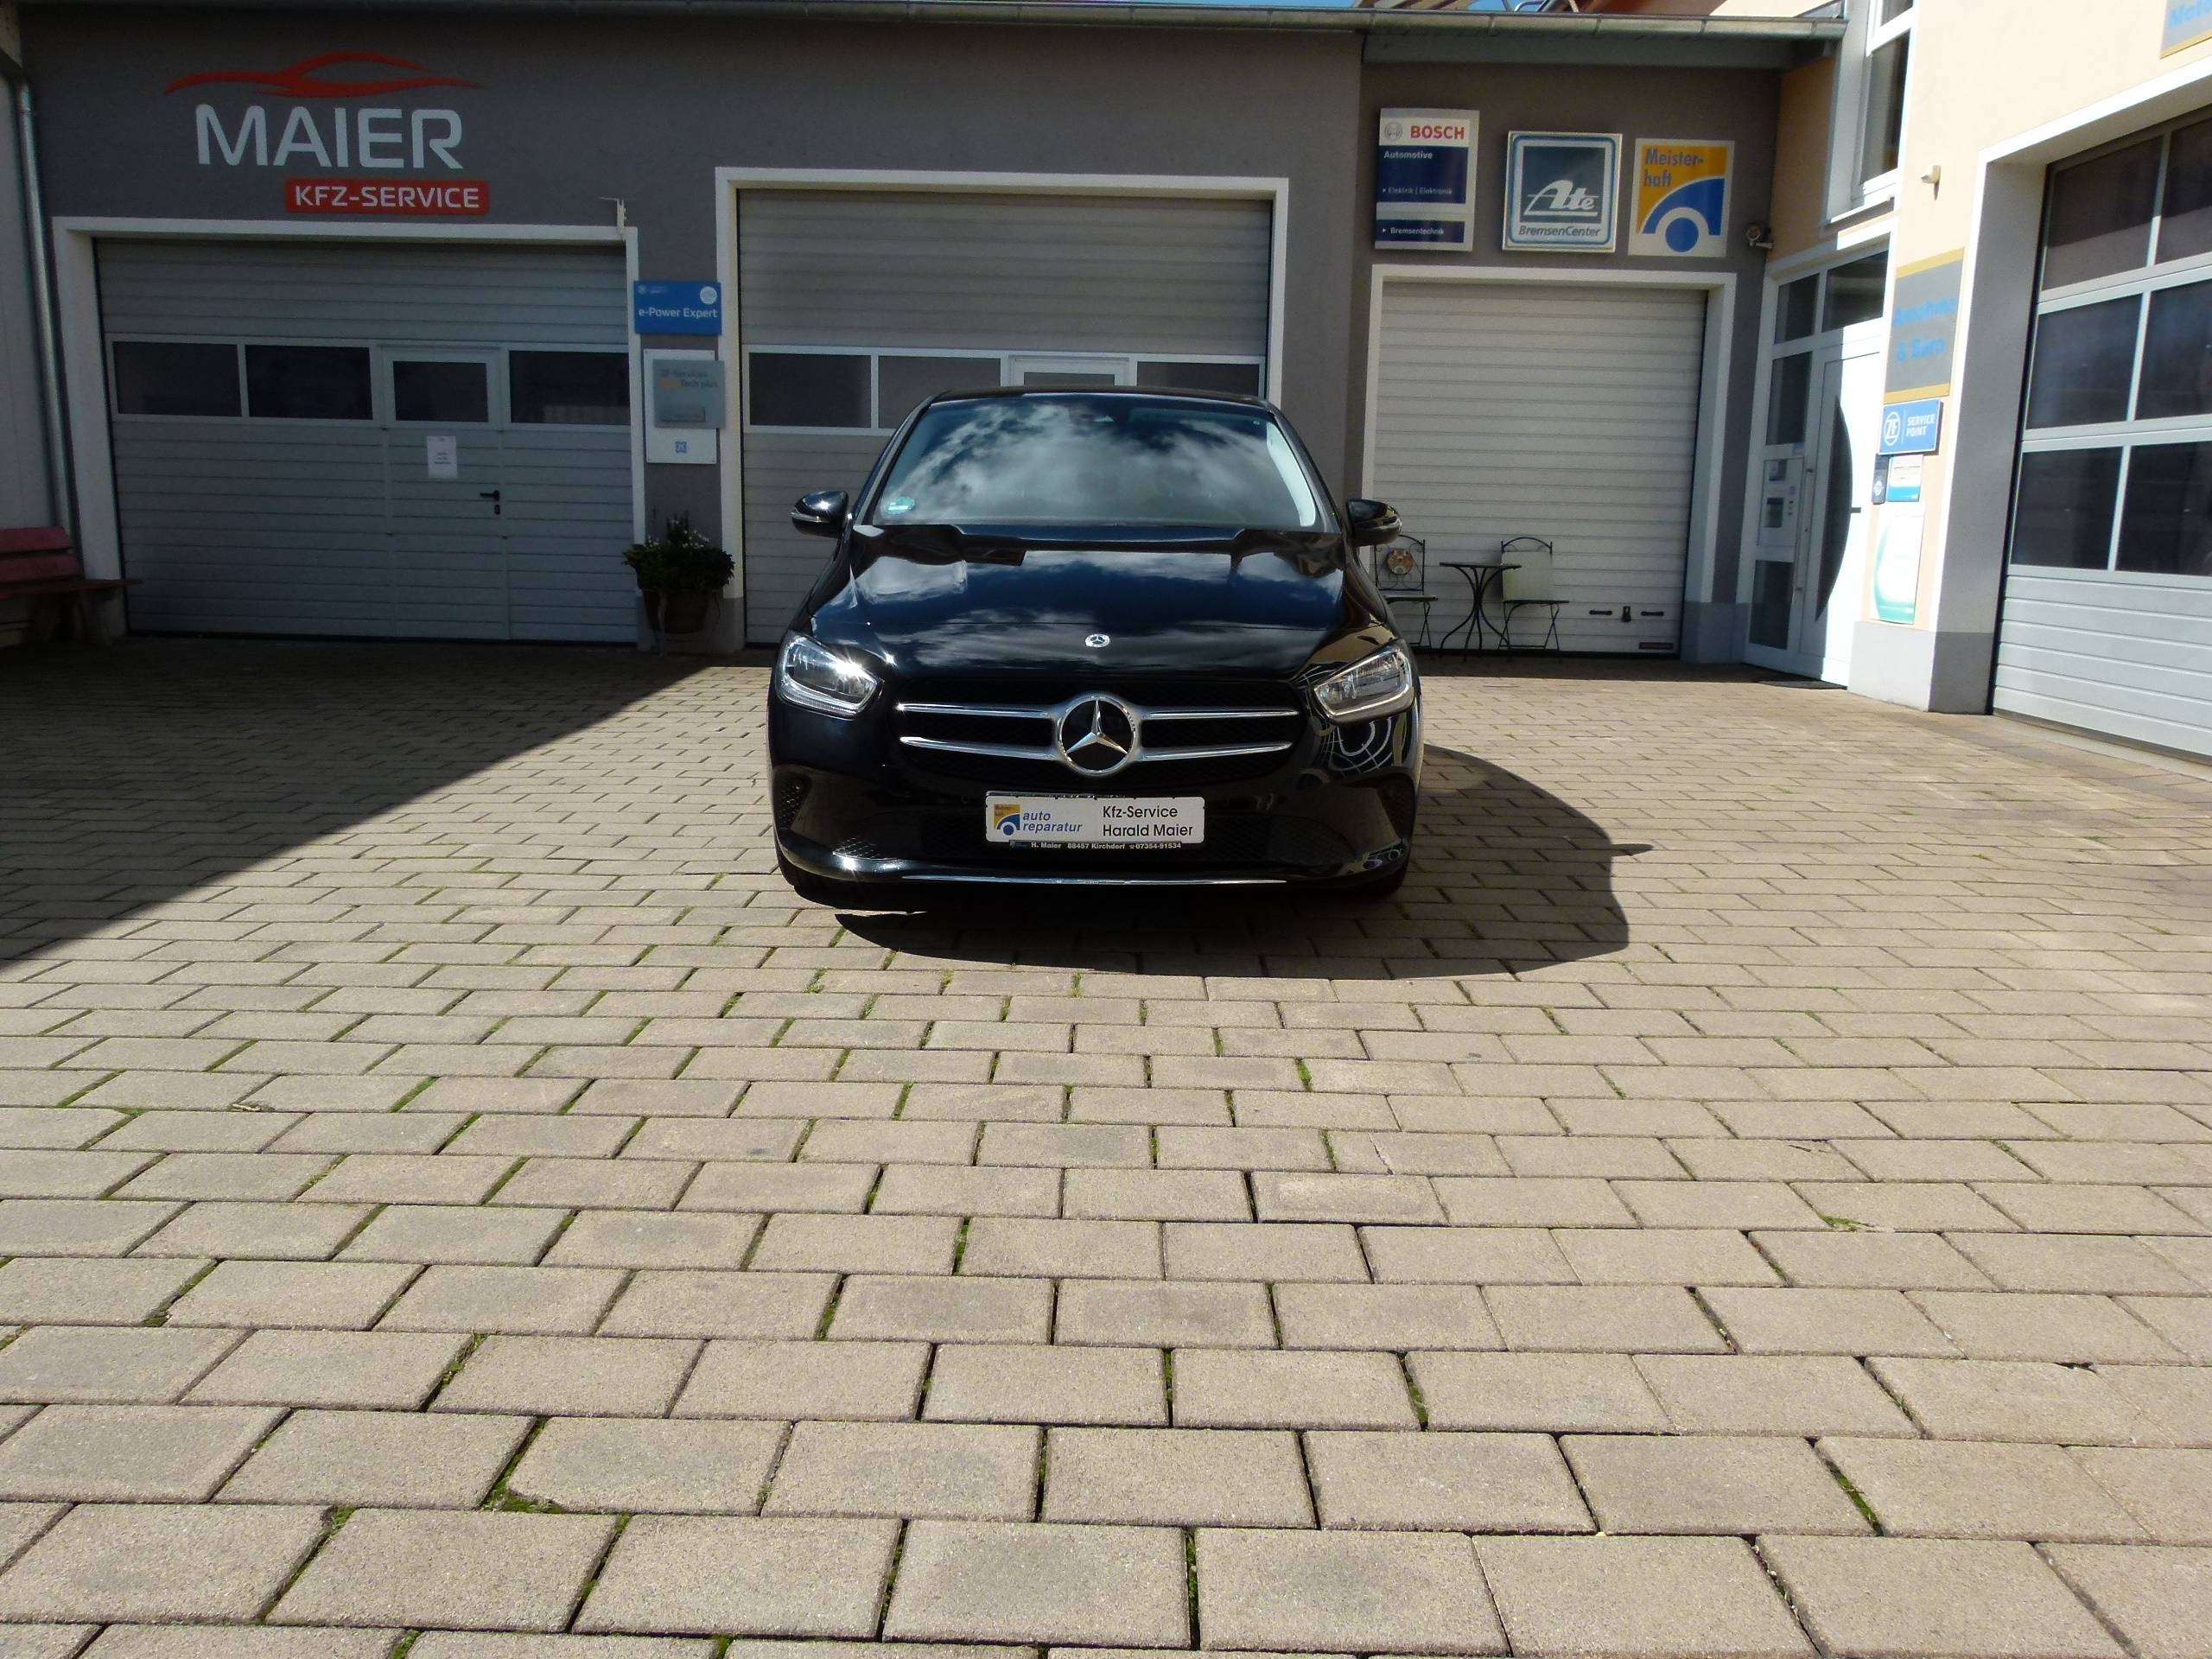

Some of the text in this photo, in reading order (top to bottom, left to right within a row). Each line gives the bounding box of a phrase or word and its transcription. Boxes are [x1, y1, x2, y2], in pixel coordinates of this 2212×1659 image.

[194, 103, 464, 170] MAIER
[1409, 125, 1465, 140] BOSCH
[1383, 150, 1434, 160] Automotive
[1643, 169, 1673, 188] haft
[295, 184, 480, 209] KFZ-SERVICE
[1389, 226, 1445, 236] Bremsentechnik
[1518, 225, 1601, 238] BremsenCenter
[638, 307, 719, 320] e-Power Expert
[1907, 414, 1936, 427] SERVICE
[1906, 426, 1928, 437] POINT
[1022, 810, 1052, 821] auto
[1102, 804, 1179, 819] Kfz-Service
[1022, 822, 1084, 834] reparatur
[1102, 823, 1193, 837] Harald Maier
